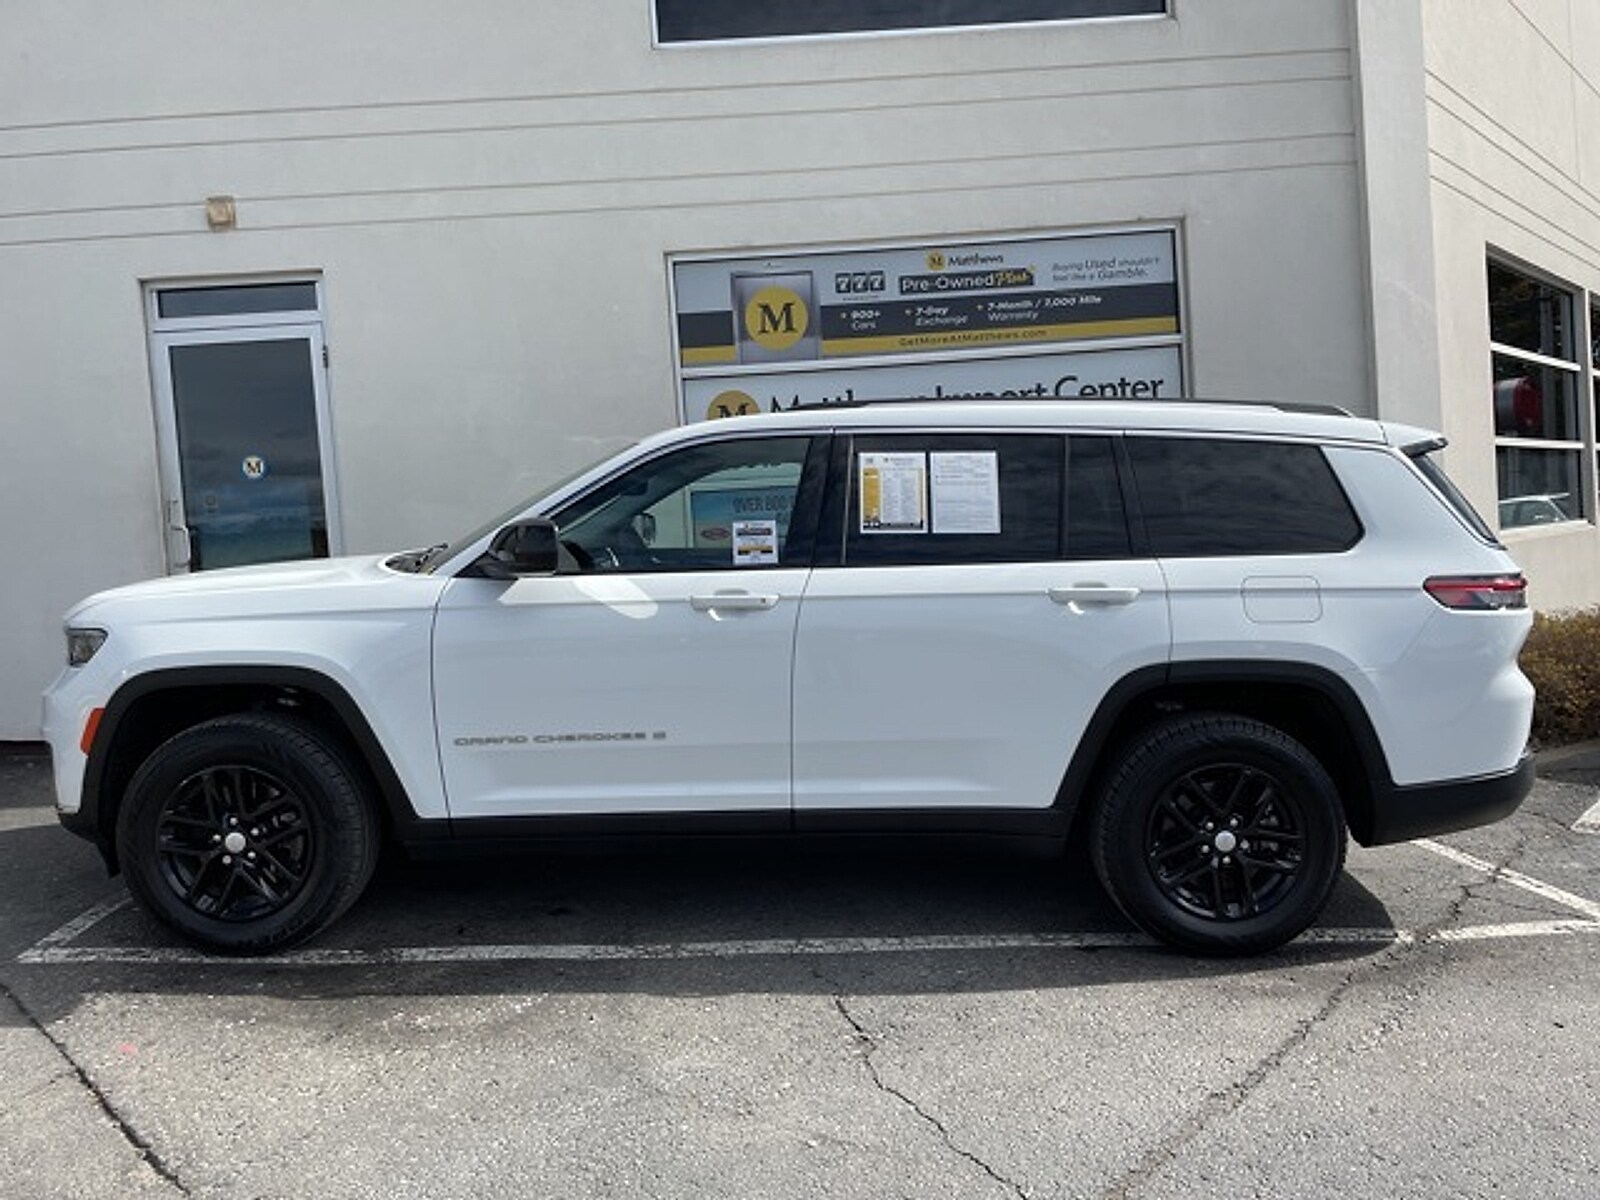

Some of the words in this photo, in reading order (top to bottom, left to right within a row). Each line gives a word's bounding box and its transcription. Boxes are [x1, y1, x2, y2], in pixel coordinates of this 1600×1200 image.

[947, 252, 1004, 267] Matthews
[1085, 257, 1115, 270] Used
[902, 273, 994, 292] Pre-Owned
[1079, 294, 1102, 305] Mile
[757, 302, 798, 334] M
[915, 313, 968, 329] Exchange
[988, 309, 1039, 323] Warranty
[852, 319, 877, 331] Cars
[900, 328, 1047, 347] GetMoreAtMatthews.com
[454, 735, 528, 747] GRAND
[533, 732, 646, 745] CHEROKEE
